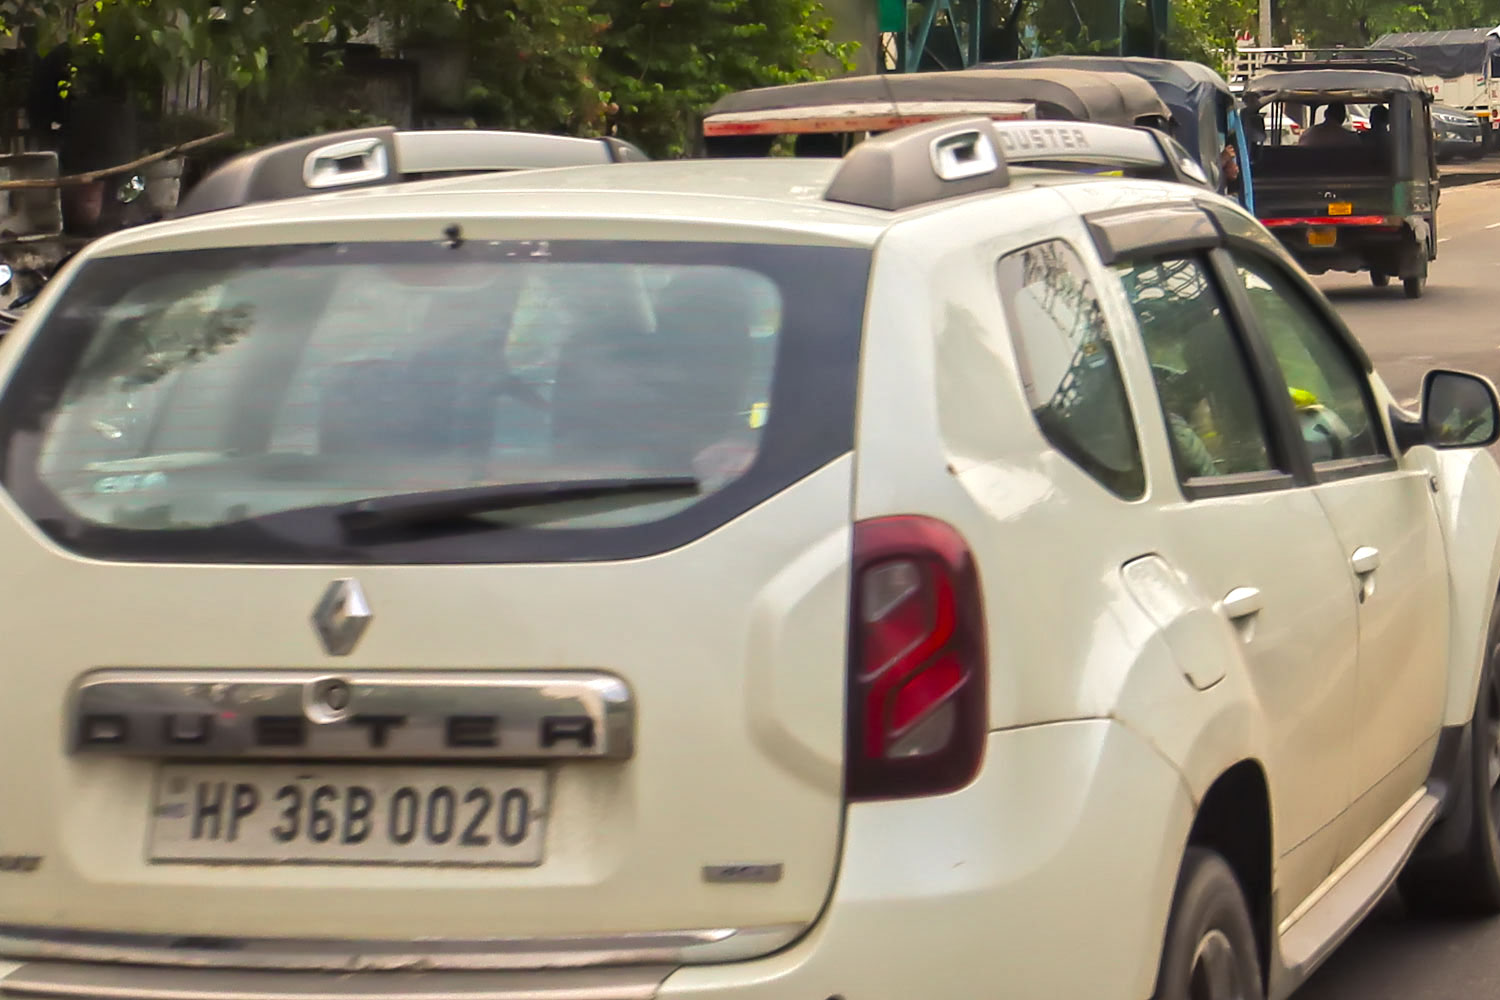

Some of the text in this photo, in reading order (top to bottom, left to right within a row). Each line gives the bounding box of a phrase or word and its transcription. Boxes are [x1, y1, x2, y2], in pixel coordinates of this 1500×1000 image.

[999, 127, 1091, 151] DUSTER
[76, 713, 597, 749] DUSTER
[191, 781, 532, 847] HP 36B 0020
